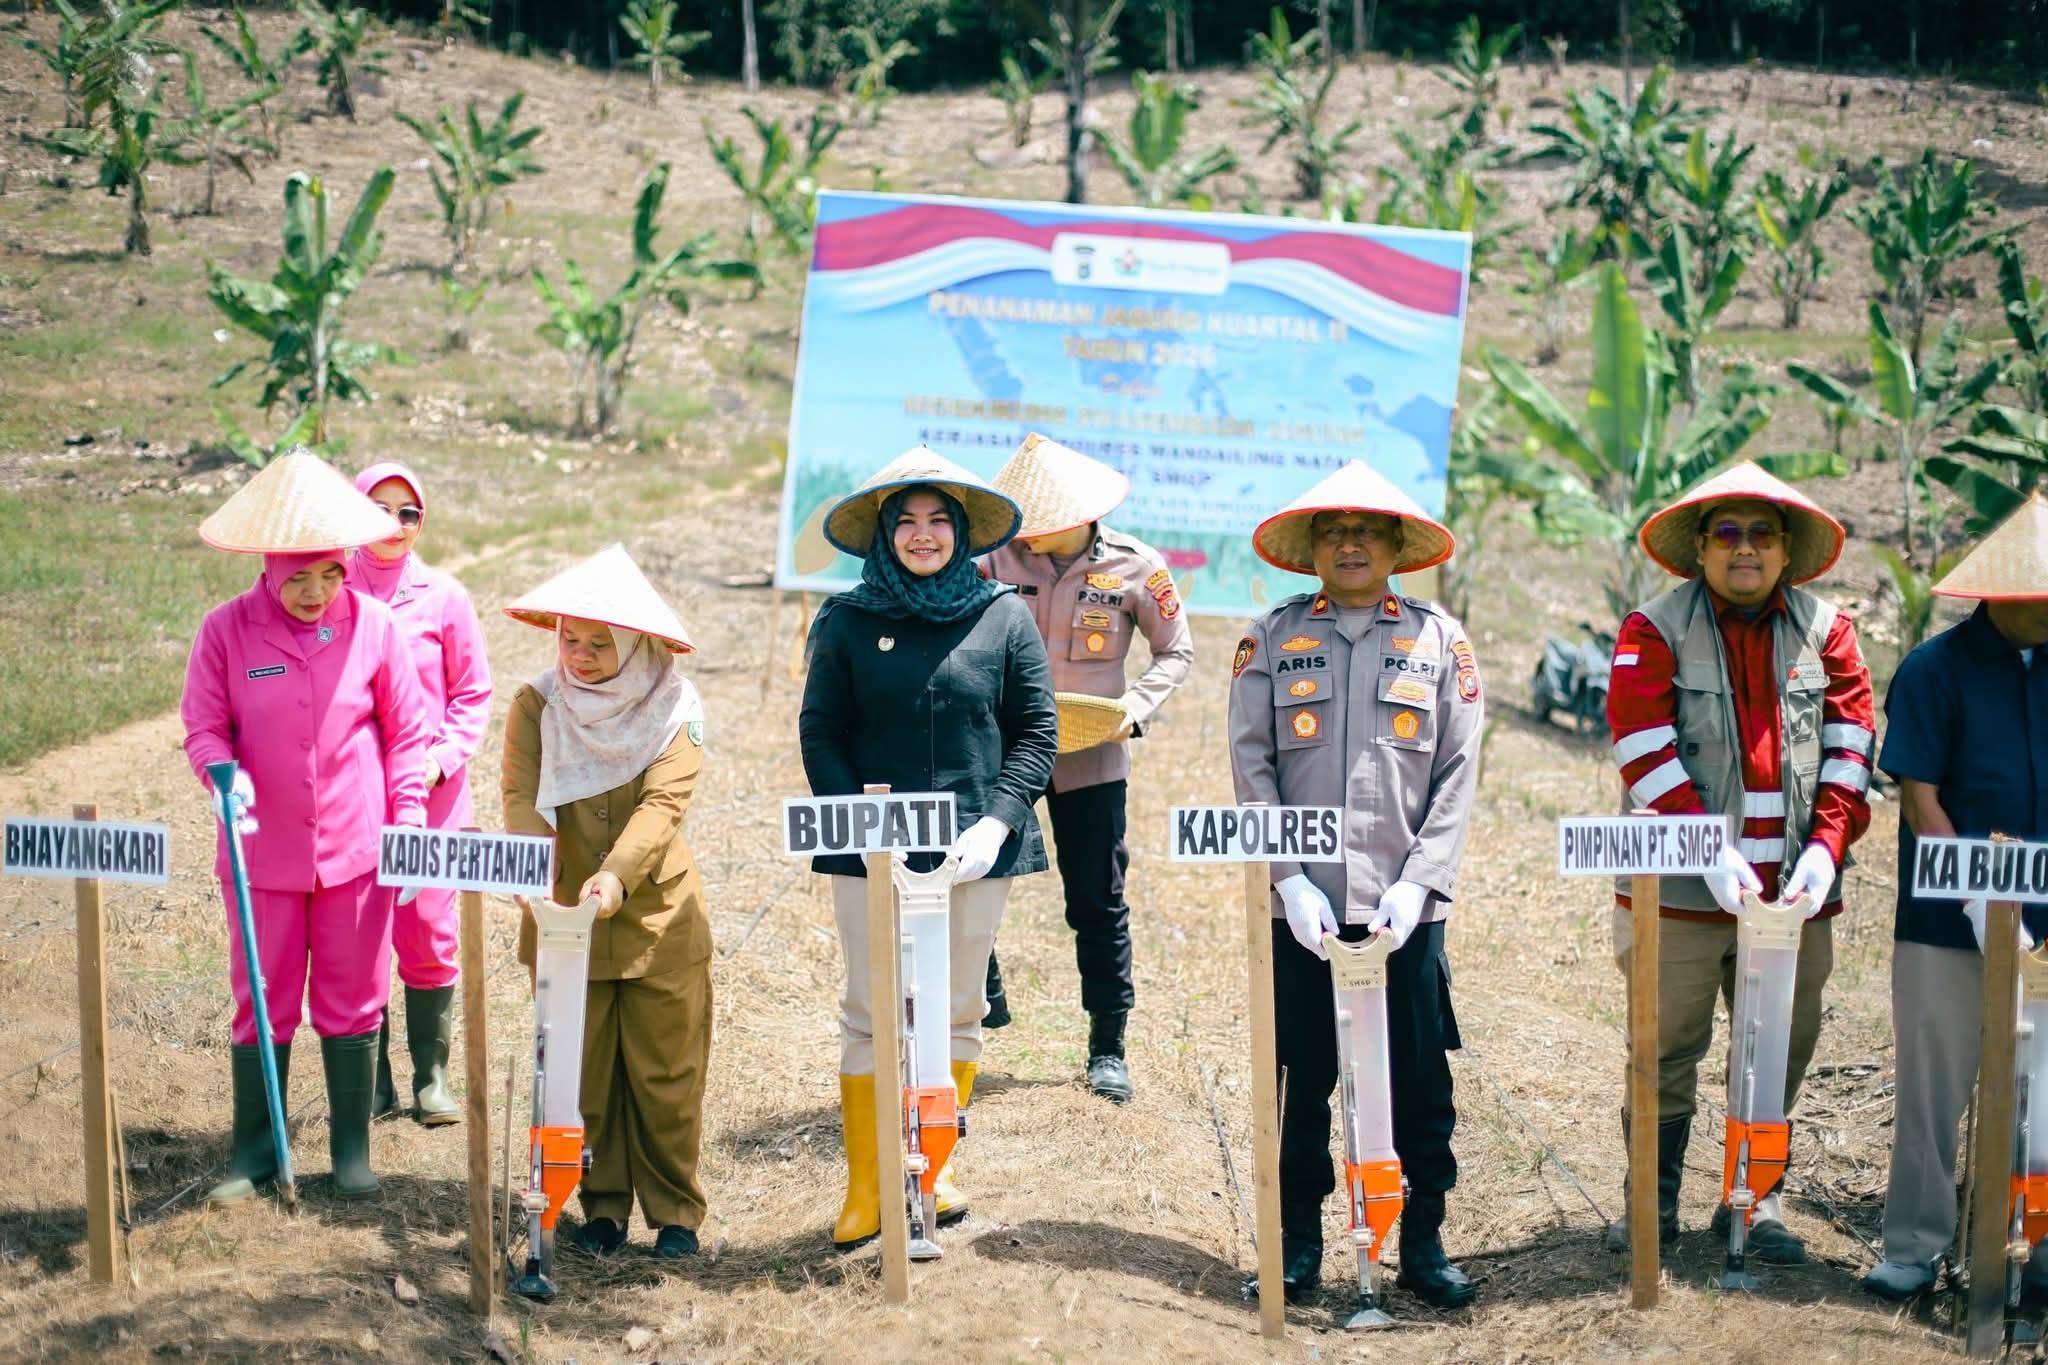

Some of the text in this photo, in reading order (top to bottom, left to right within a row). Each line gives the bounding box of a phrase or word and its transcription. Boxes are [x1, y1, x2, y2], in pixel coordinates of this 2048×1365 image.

[928, 290, 1094, 325] PENANAMAN
[1102, 305, 1201, 333] JAGUNG
[1206, 311, 1320, 343] KUARTAL
[1064, 335, 1147, 364] TAHUN
[1078, 590, 1124, 607] POLRI
[1277, 655, 1436, 677] ARIS POLRI
[5, 823, 164, 876] BHAYANGKARI
[788, 800, 953, 852] BUPATI
[1178, 809, 1338, 856] KAPOLRES
[1564, 824, 1723, 869] PIMPINAN PT. SMGP
[381, 832, 550, 887] KADIS PERTANIAN
[1917, 843, 1960, 891] KA
